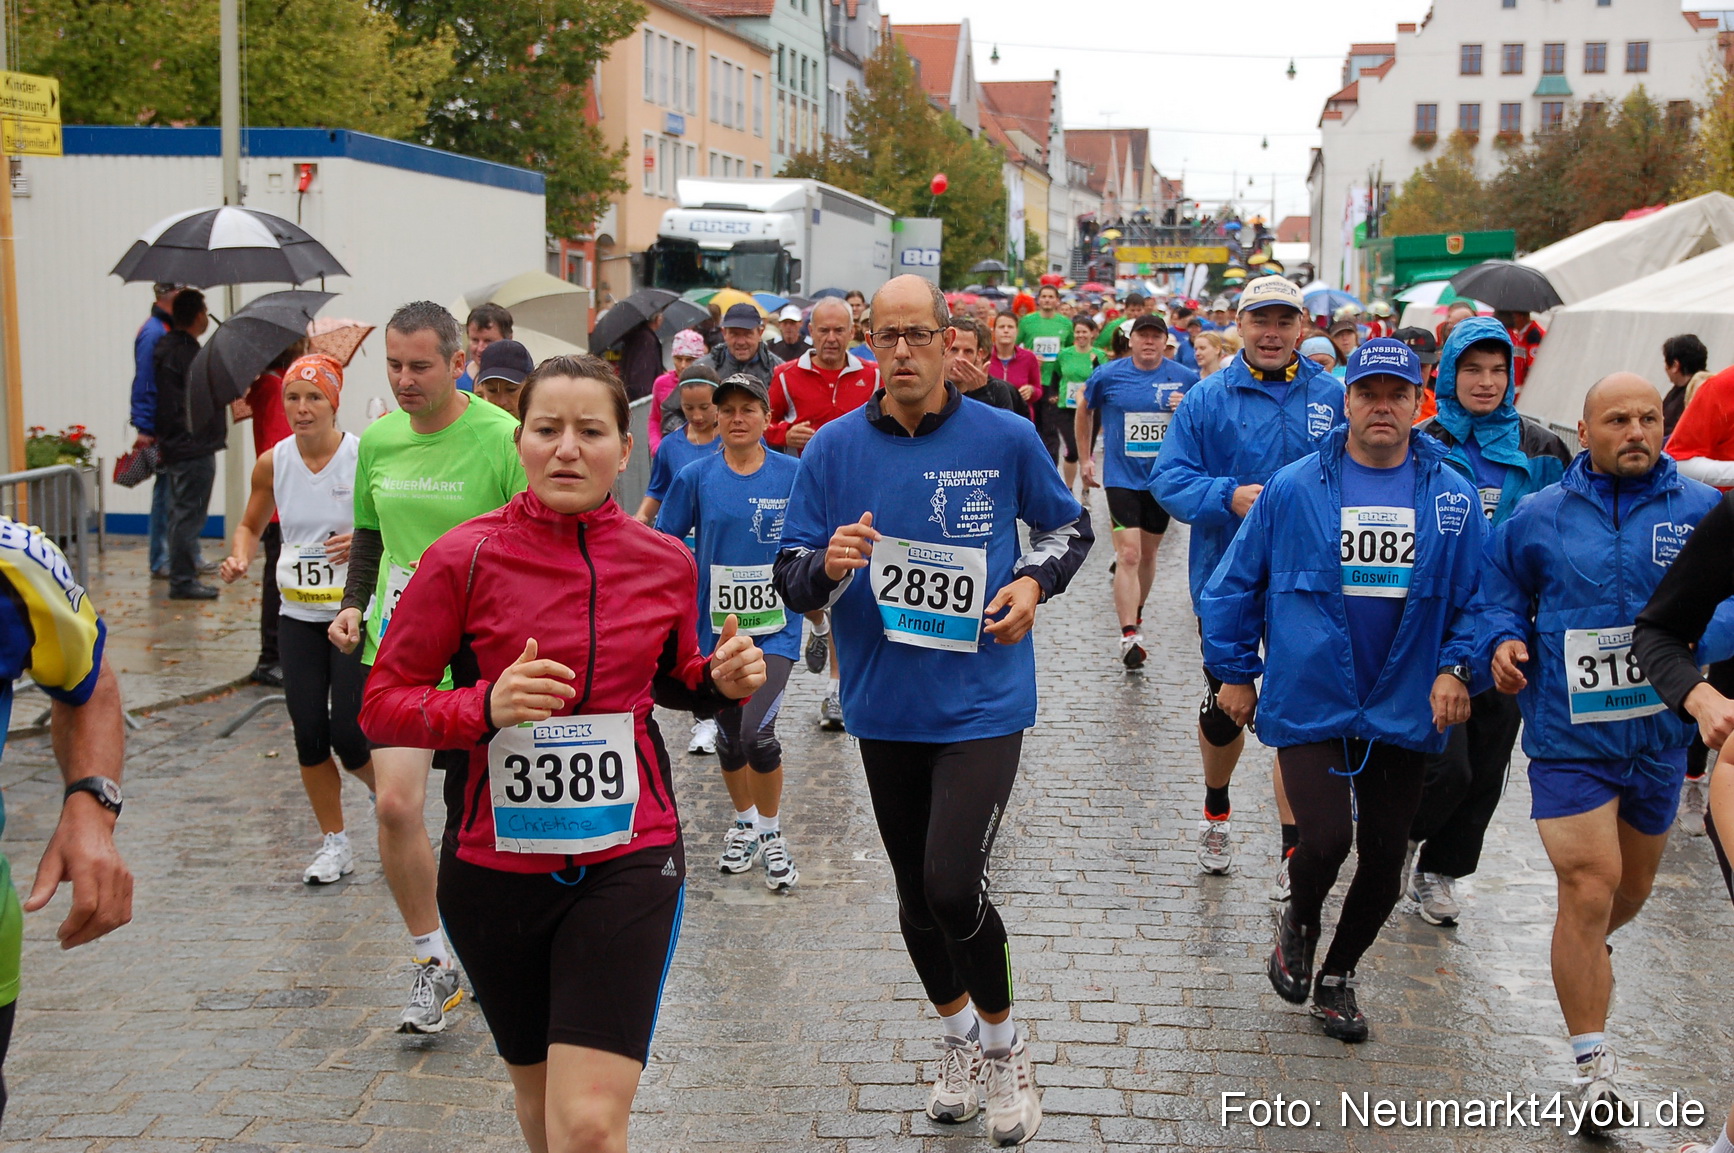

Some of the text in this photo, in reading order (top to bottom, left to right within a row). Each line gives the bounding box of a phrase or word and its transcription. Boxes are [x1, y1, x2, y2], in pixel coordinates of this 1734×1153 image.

[690, 220, 751, 234] BOCK
[1151, 249, 1191, 261] START
[1036, 344, 1057, 353] 2767
[1361, 346, 1408, 356] GANSBRÄU
[923, 469, 1000, 480] 12. NEUMARKTER
[937, 478, 988, 487] STADTLAUF
[1358, 512, 1398, 522] BOCK
[1340, 530, 1416, 563] 3082
[908, 547, 954, 562] BOCK
[1352, 570, 1399, 584] Goswin
[879, 564, 974, 613] 2839
[718, 584, 777, 610] 5083
[897, 613, 946, 634] Arnold
[1604, 692, 1647, 708] Armin
[533, 723, 593, 740] BOCK
[504, 751, 625, 803] 3389
[508, 815, 598, 832] Christine
